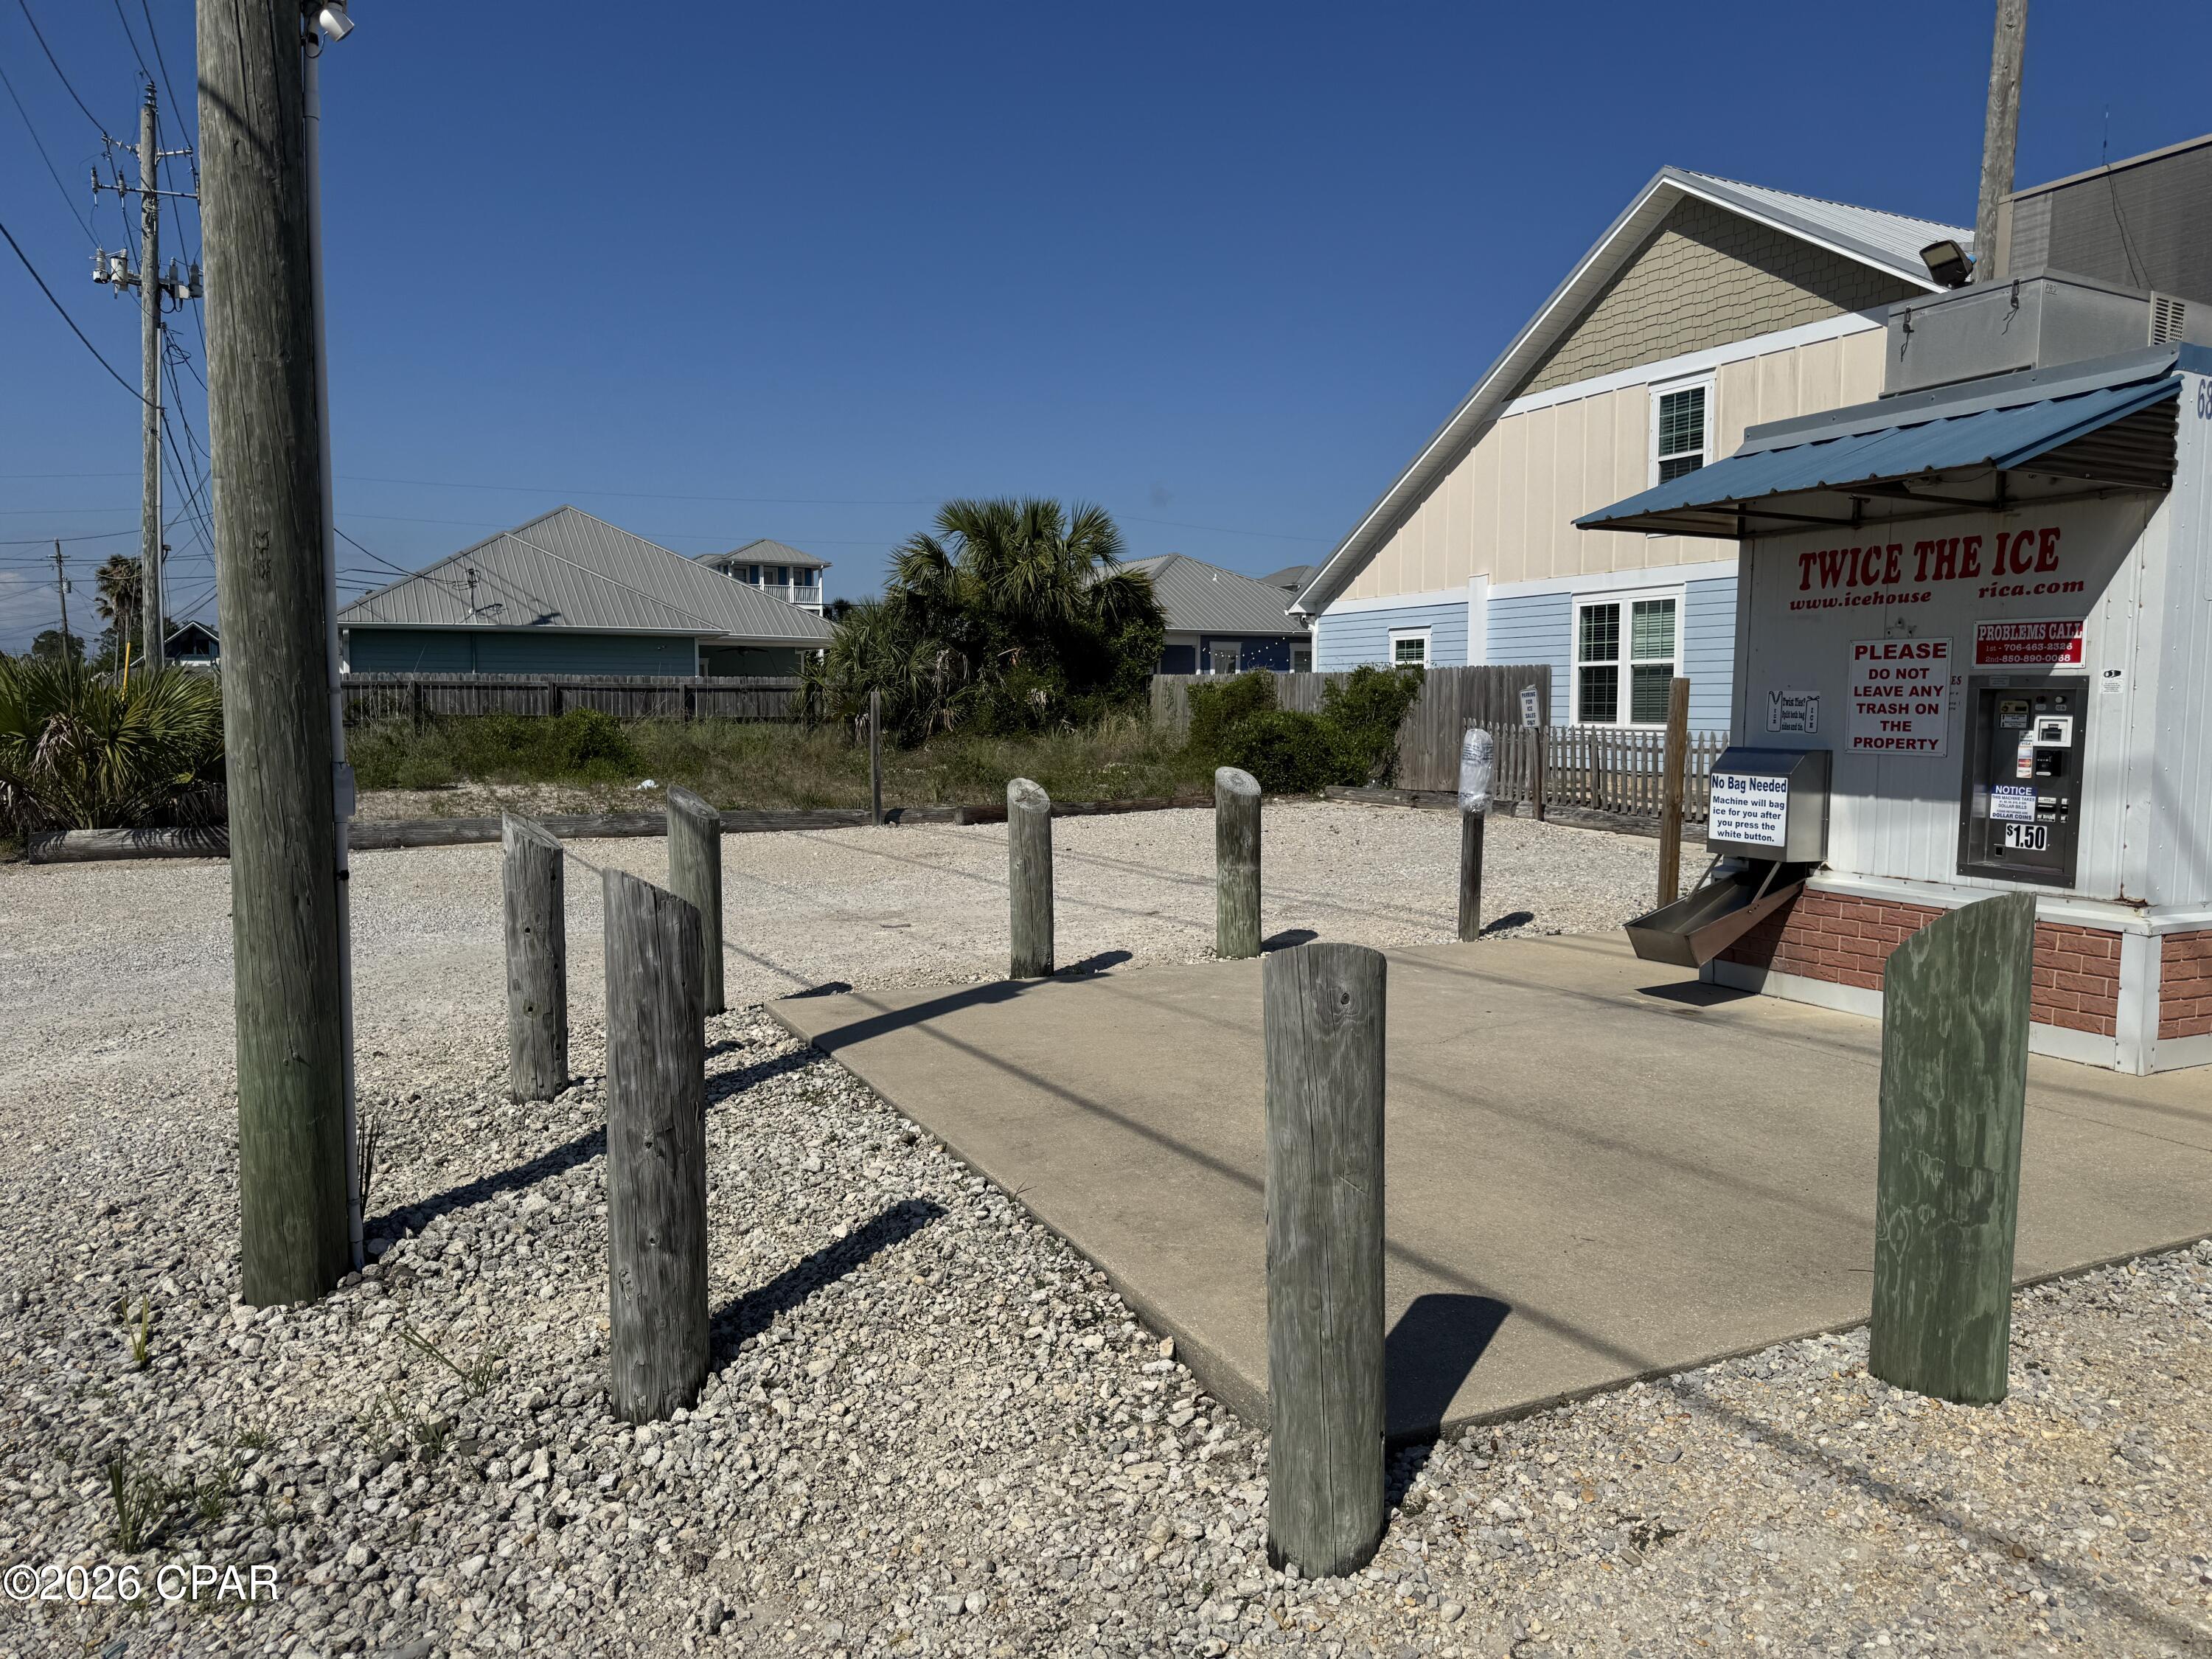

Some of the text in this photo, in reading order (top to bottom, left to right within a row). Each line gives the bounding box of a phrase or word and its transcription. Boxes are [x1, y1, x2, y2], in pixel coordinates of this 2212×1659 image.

[2197, 379, 2212, 420] 68
[1798, 526, 2061, 591] TWICE THE ICE
[1790, 580, 2085, 611] www.icehouse rica.com
[1978, 622, 2083, 641] PROBLEMS CALL
[1854, 642, 1947, 661] PLEASE
[1868, 667, 1930, 680] DO NOT
[1854, 685, 1944, 697] LEAVE ANY
[1783, 697, 1794, 706] Twist
[1856, 703, 1909, 714] TRASH
[1915, 703, 1939, 714] ON
[1880, 720, 1912, 732] THE
[1853, 737, 1939, 751] PROPERTY
[1712, 775, 1787, 793] No Bag Needed
[1995, 785, 2032, 796] NOTICE
[1713, 796, 1784, 810] Machine will bag
[1713, 807, 1726, 815] ice
[1761, 811, 1781, 820] after
[1761, 822, 1775, 830] the
[1717, 830, 1774, 842] white button.
[2007, 824, 2045, 849] $1.50
